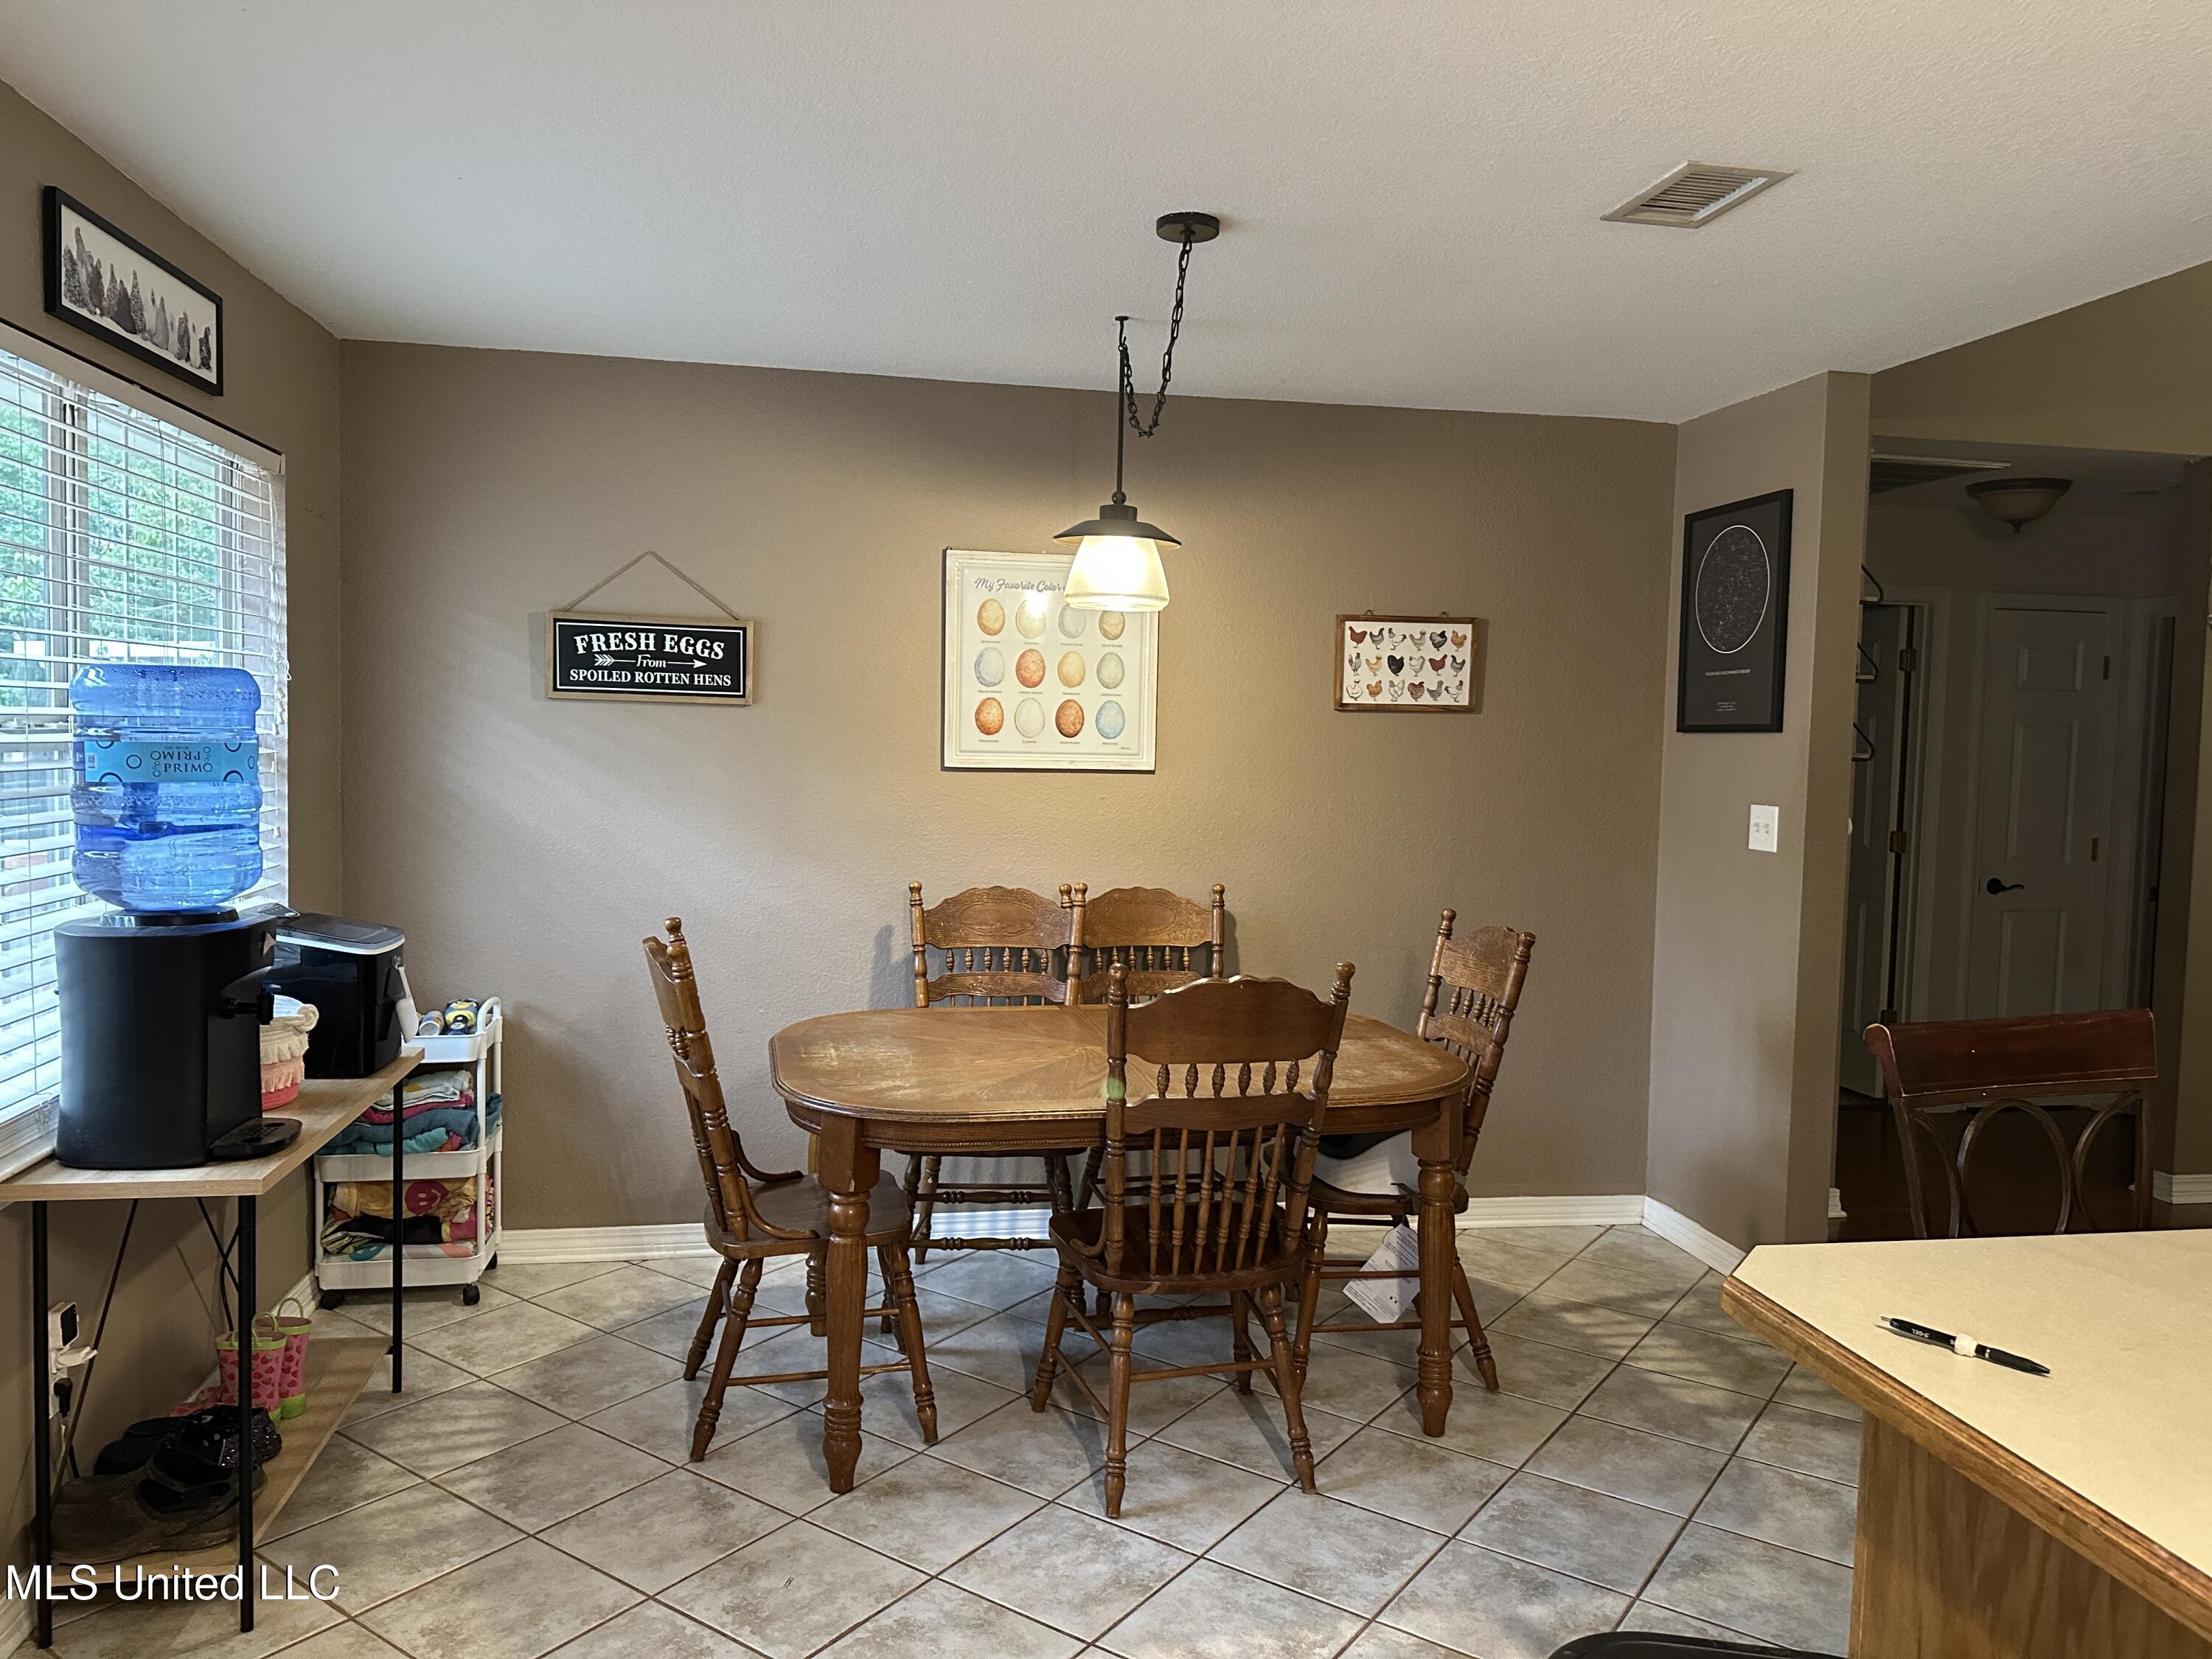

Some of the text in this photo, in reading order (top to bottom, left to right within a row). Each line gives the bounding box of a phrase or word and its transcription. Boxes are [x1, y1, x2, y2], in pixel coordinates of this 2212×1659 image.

[975, 577, 995, 591] My
[996, 578, 1035, 591] Favorite
[574, 632, 725, 660] FRESH EGGS
[636, 654, 667, 668] From
[569, 668, 731, 686] SPOILED ROTTEN HENS
[150, 751, 201, 760] PRIMO
[164, 762, 212, 773] PRIMO
